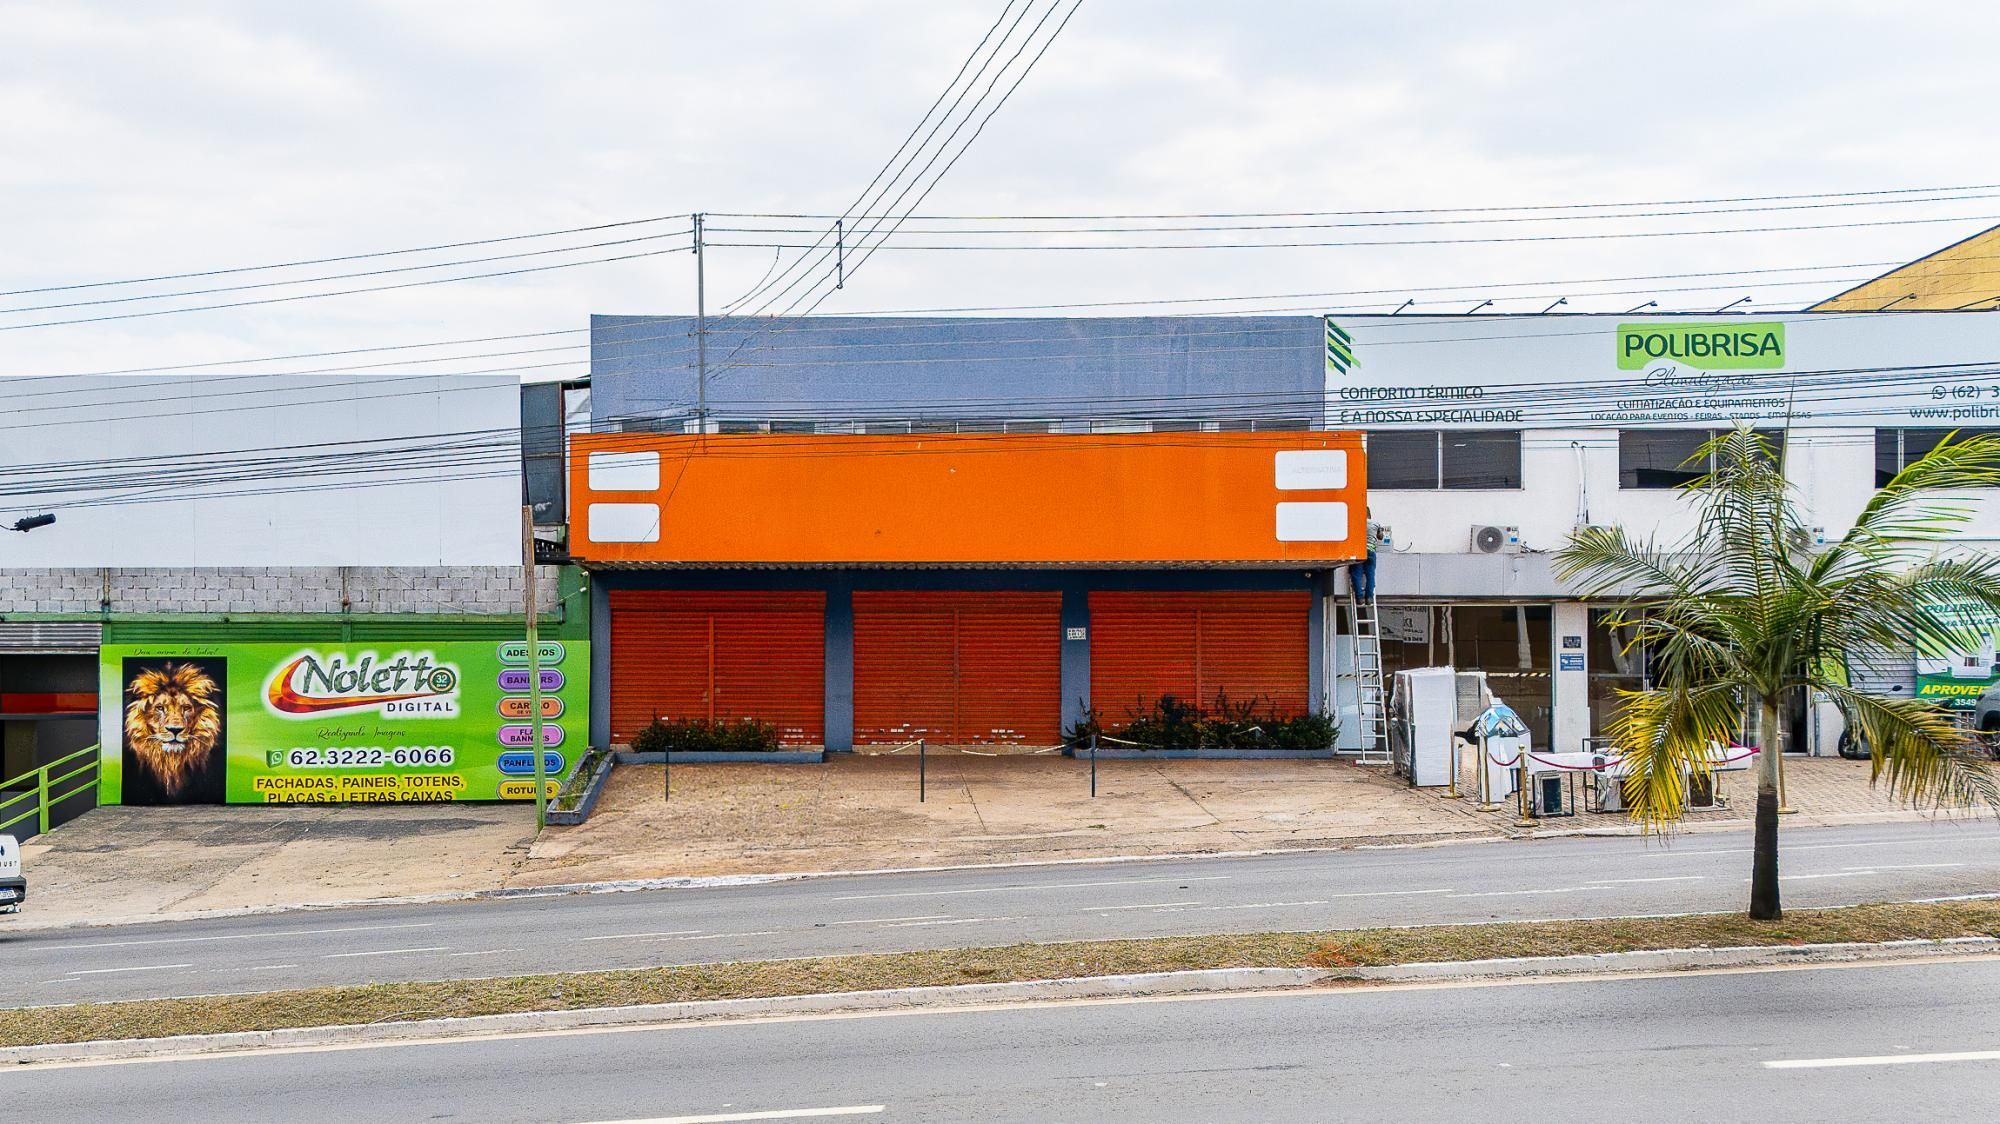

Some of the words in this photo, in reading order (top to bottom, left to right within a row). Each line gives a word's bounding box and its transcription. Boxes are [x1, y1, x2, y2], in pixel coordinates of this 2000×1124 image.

[1625, 332, 1782, 358] POLIBRISA
[1340, 386, 1415, 400] CONFORTO
[1419, 384, 1484, 400] TÉRMICO
[1952, 385, 1981, 400] (62)
[1352, 410, 1362, 422] A
[1365, 410, 1413, 423] NOSSA
[1416, 409, 1525, 423] ESPECIALIDADE
[1909, 406, 2000, 421] www.polibri
[506, 649, 555, 657] ADEOS
[436, 674, 448, 684] 32
[506, 675, 554, 684] BANRS
[387, 702, 454, 712] DIGITAL
[510, 702, 550, 710] CARO
[290, 748, 453, 765] 62.3222-6066
[503, 759, 557, 767] PANFLOS
[256, 778, 339, 790] FACHADAS,
[342, 777, 400, 789] PAINEIS,
[405, 776, 465, 788] TOTENS,
[400, 790, 454, 801] CAIXAS
[507, 787, 554, 795] ROTUS
